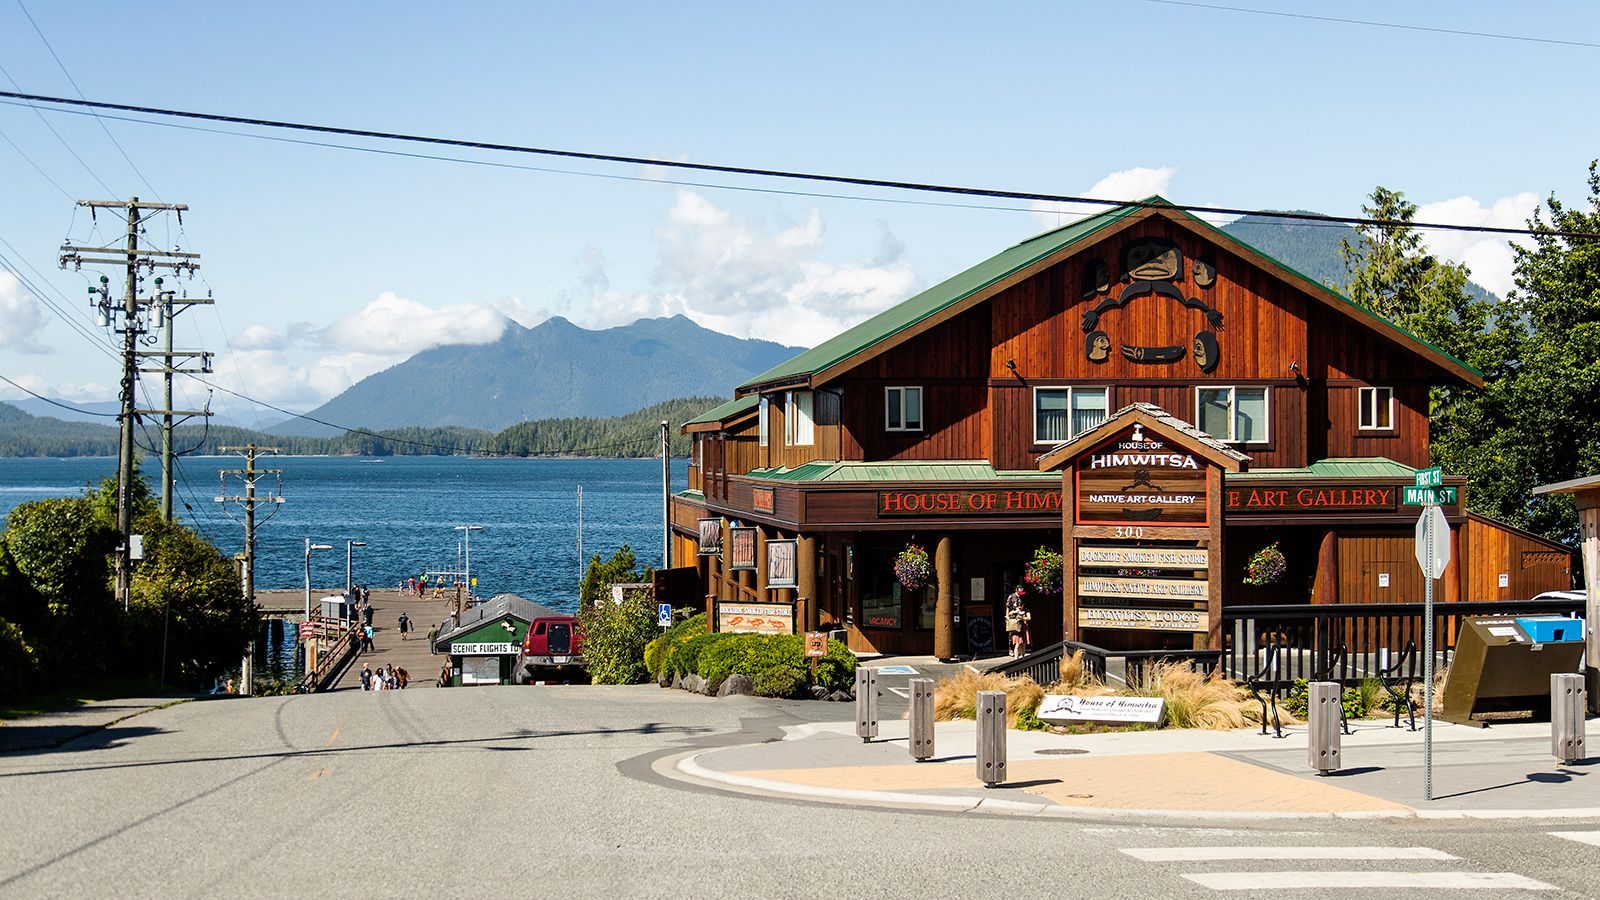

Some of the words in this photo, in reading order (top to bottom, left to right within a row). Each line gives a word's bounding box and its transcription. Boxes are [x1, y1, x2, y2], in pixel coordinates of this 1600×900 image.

[1118, 442, 1150, 450] HOUSE
[1150, 442, 1164, 450] OF
[1091, 454, 1198, 470] HIMWITSA
[1416, 471, 1431, 486] FIRST
[1432, 470, 1441, 484] ST
[883, 493, 962, 511] HOUSE
[969, 493, 998, 510] OF
[1246, 489, 1289, 507] ART
[1297, 488, 1390, 507] GALLERY
[1089, 495, 1128, 503] NATIVE
[1127, 495, 1148, 503] ART
[1148, 495, 1196, 504] GALLERY
[1407, 489, 1435, 503] MAIN
[1439, 490, 1453, 503] ST
[1115, 526, 1143, 538] 300
[1080, 551, 1121, 562] DOCKSIDE
[1123, 552, 1157, 563] SMOKED
[1158, 553, 1177, 564] FISH
[1179, 553, 1206, 564] STORE
[1083, 581, 1121, 593] HIMWITSA
[1122, 583, 1150, 594] NATIVE
[1152, 584, 1168, 595] ART
[1169, 584, 1204, 596] GALLERY
[868, 617, 897, 626] VACANCY
[1087, 609, 1151, 622] HIMWITSA
[1155, 611, 1199, 623] LODGE
[453, 644, 477, 653] SCENIC
[479, 644, 508, 653] FLIGHTS
[1079, 698, 1104, 706] House
[1105, 699, 1116, 708] of
[1118, 700, 1158, 709] Himwitsa
